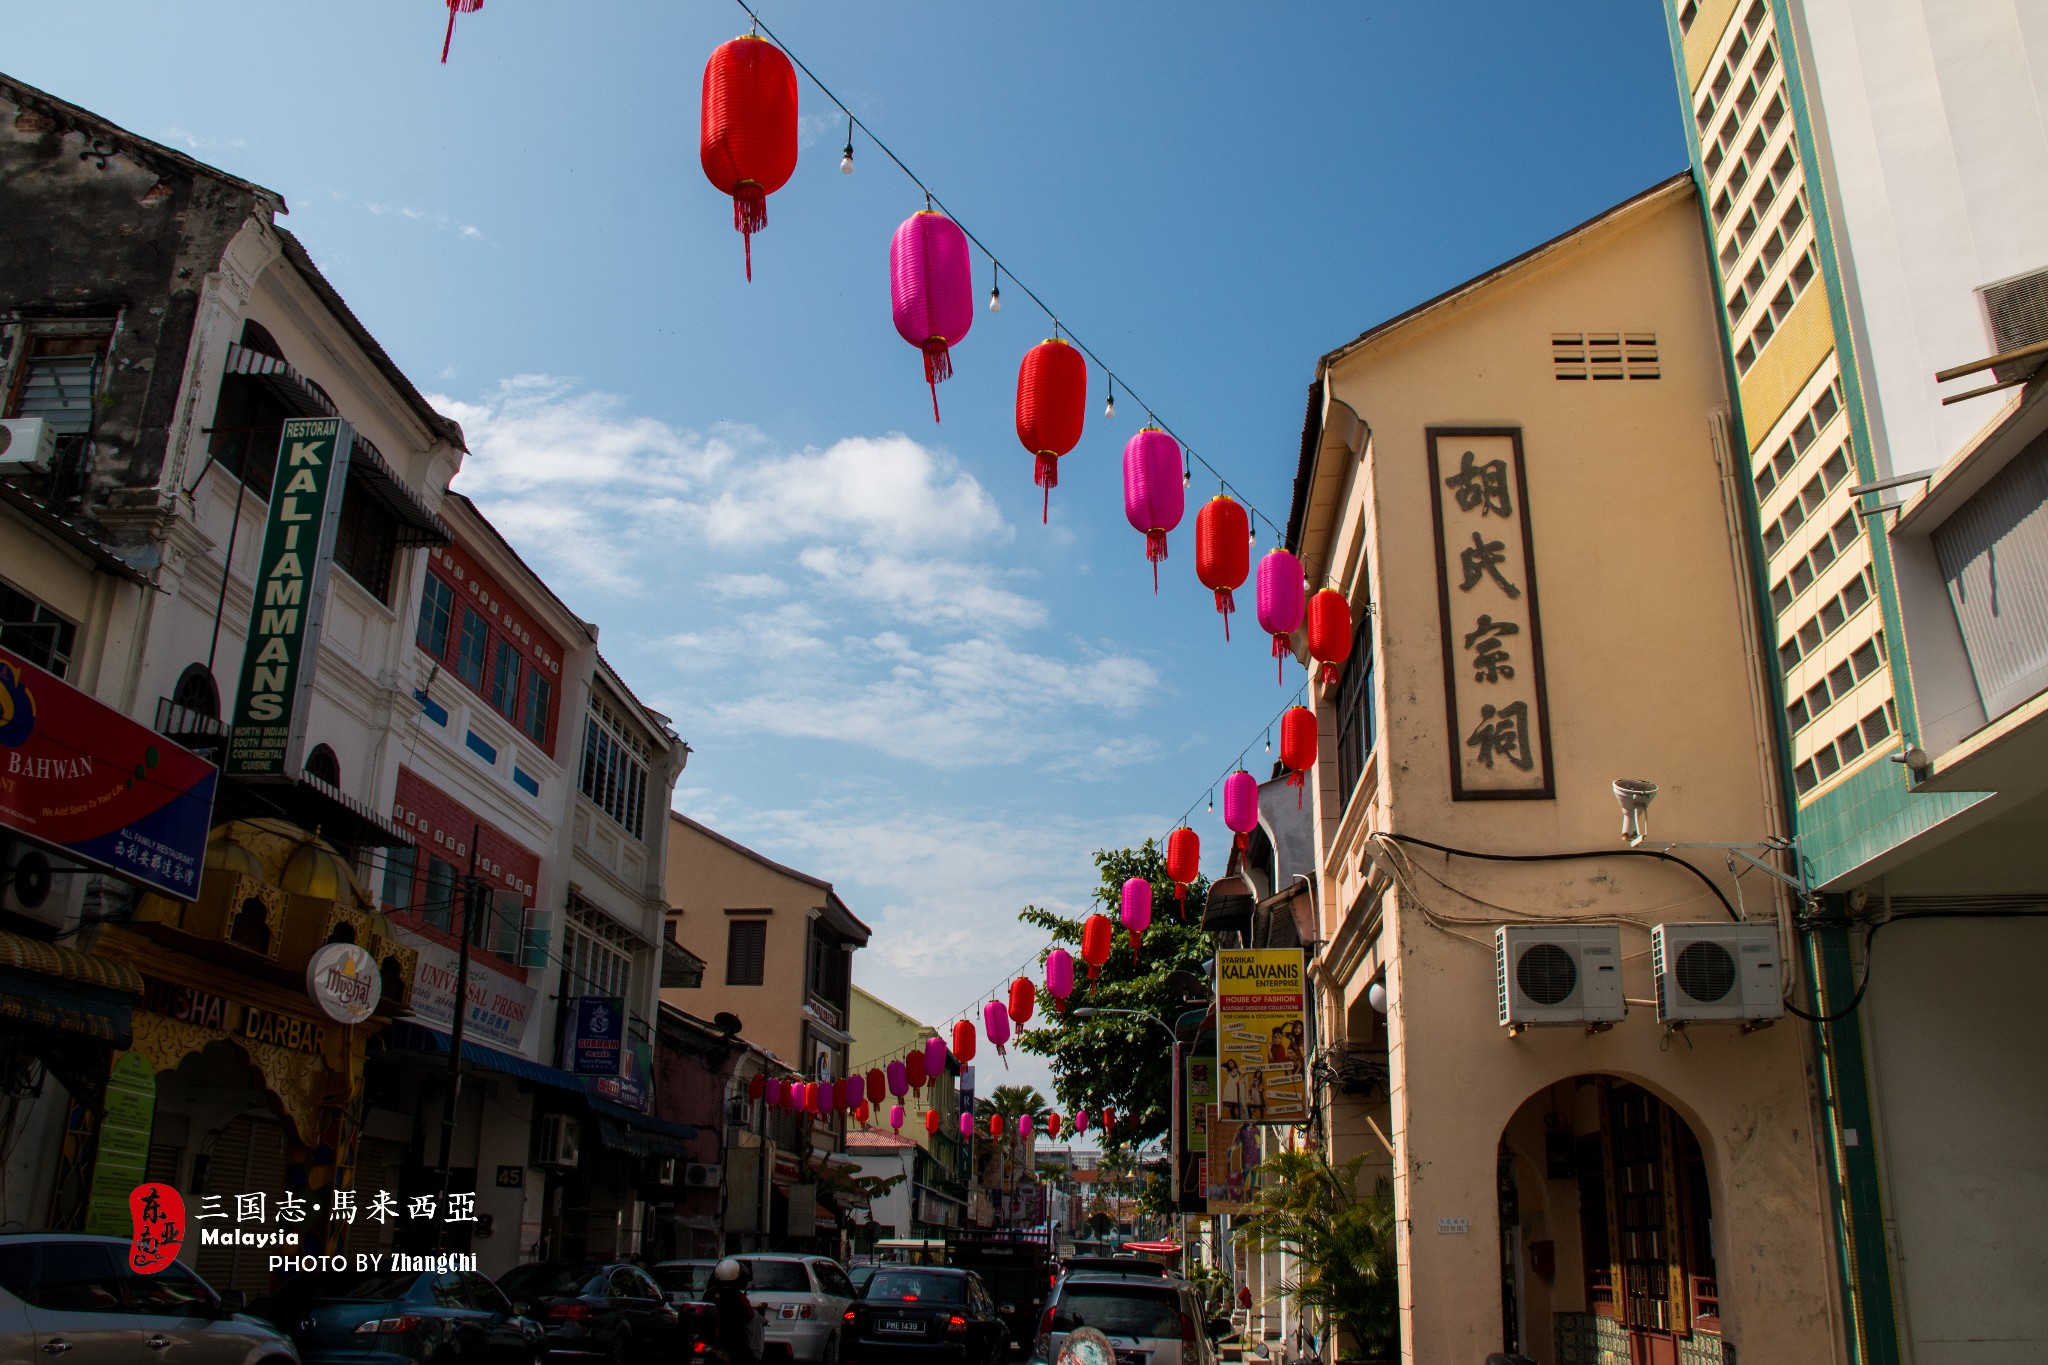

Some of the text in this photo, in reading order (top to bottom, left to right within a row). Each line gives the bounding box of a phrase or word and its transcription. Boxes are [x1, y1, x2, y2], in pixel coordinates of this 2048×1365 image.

[286, 421, 336, 437] RESTORAN
[248, 441, 326, 721] KALIAMMANS
[1445, 450, 1534, 772] 胡氏宗祠
[234, 726, 288, 736] NORTH INDIAN
[233, 738, 287, 747] SOUTH INDIAN
[232, 749, 283, 759] CONTINENTAL
[8, 751, 93, 780] BAHWAN
[242, 760, 272, 770] CUISINE
[42, 784, 125, 816] We Add Spice To Your Life
[120, 828, 194, 866] ALL FAMILY RESTAURANT
[1222, 964, 1298, 979] KALAIVANIS
[420, 963, 488, 1007] UNIVESAL
[491, 994, 526, 1022] PRESS
[245, 1006, 326, 1054] DARBAR
[578, 1039, 619, 1049] SUBHAM
[498, 1169, 521, 1185] 45
[886, 1321, 918, 1331] PME 1439
